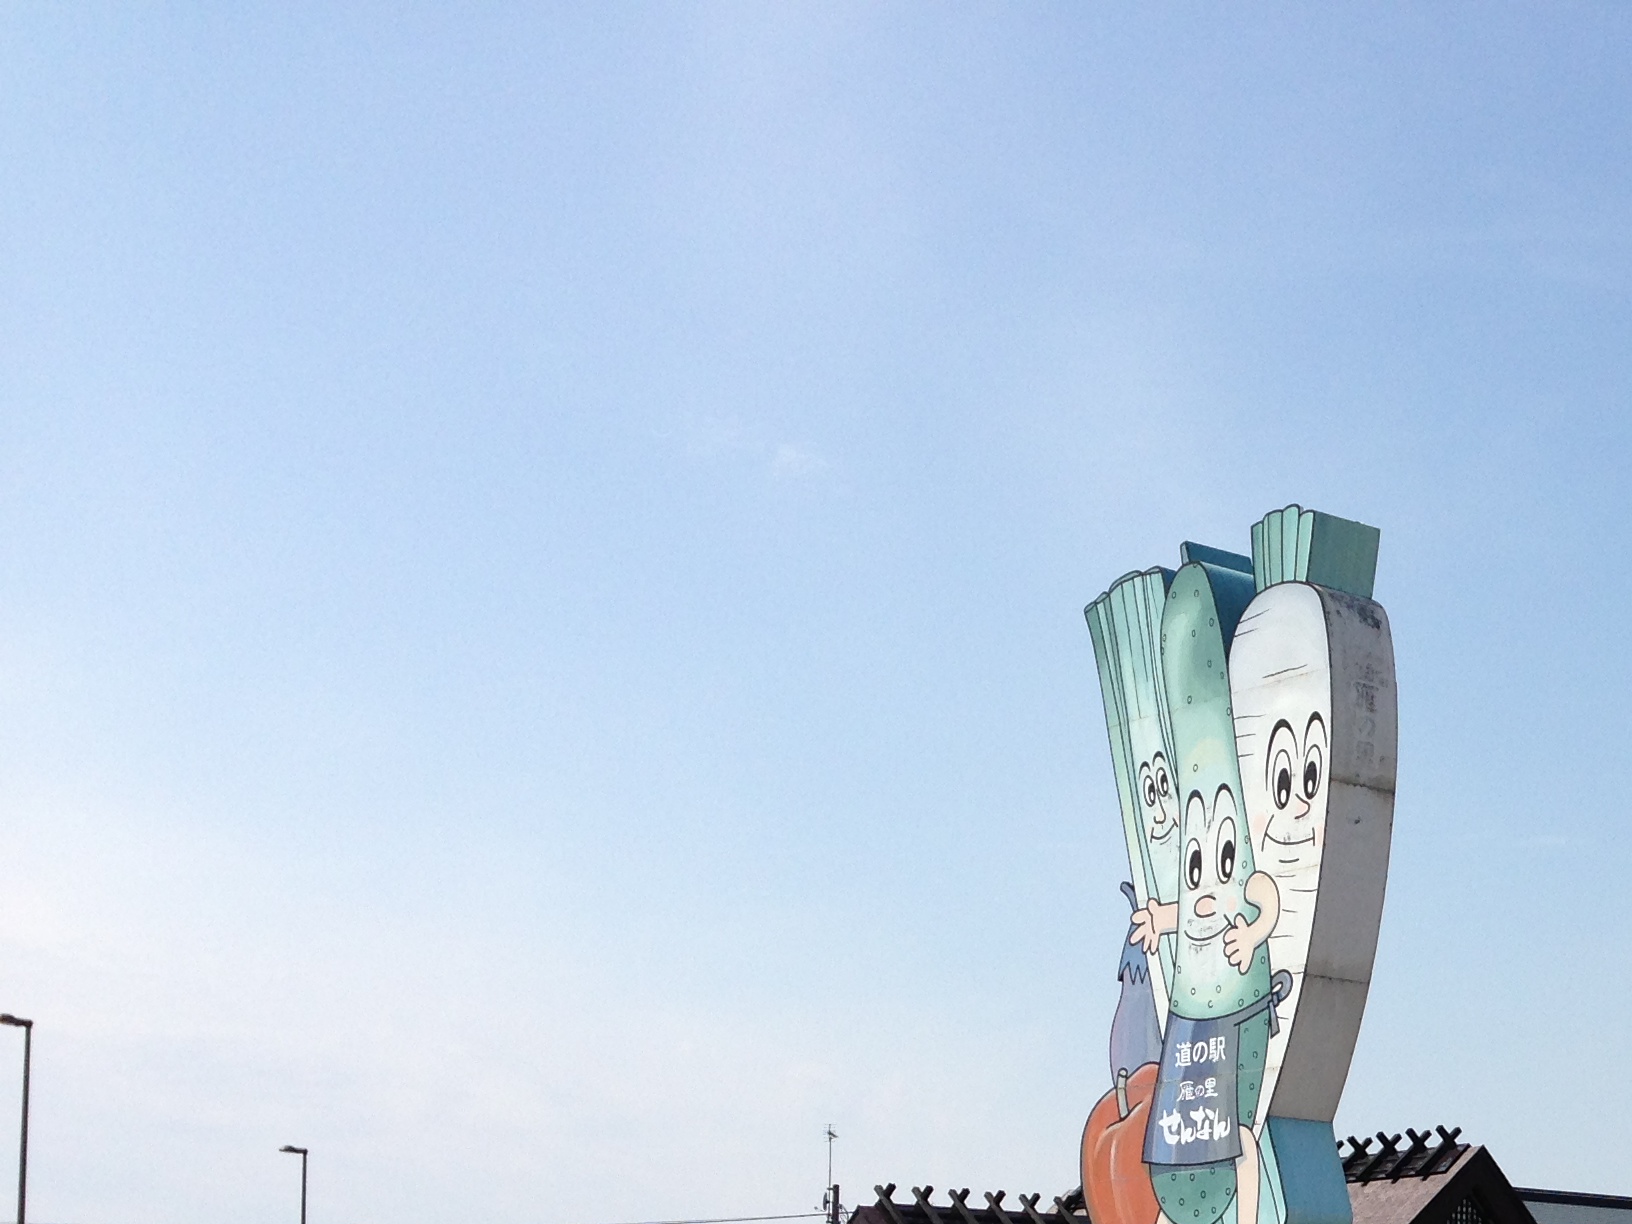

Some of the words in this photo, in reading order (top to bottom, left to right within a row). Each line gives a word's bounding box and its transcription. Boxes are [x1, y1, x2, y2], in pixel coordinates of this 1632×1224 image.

[1174, 1035, 1227, 1068] 道の駅
[1176, 1077, 1219, 1102] 雁の里
[1158, 1105, 1231, 1145] せんなん
